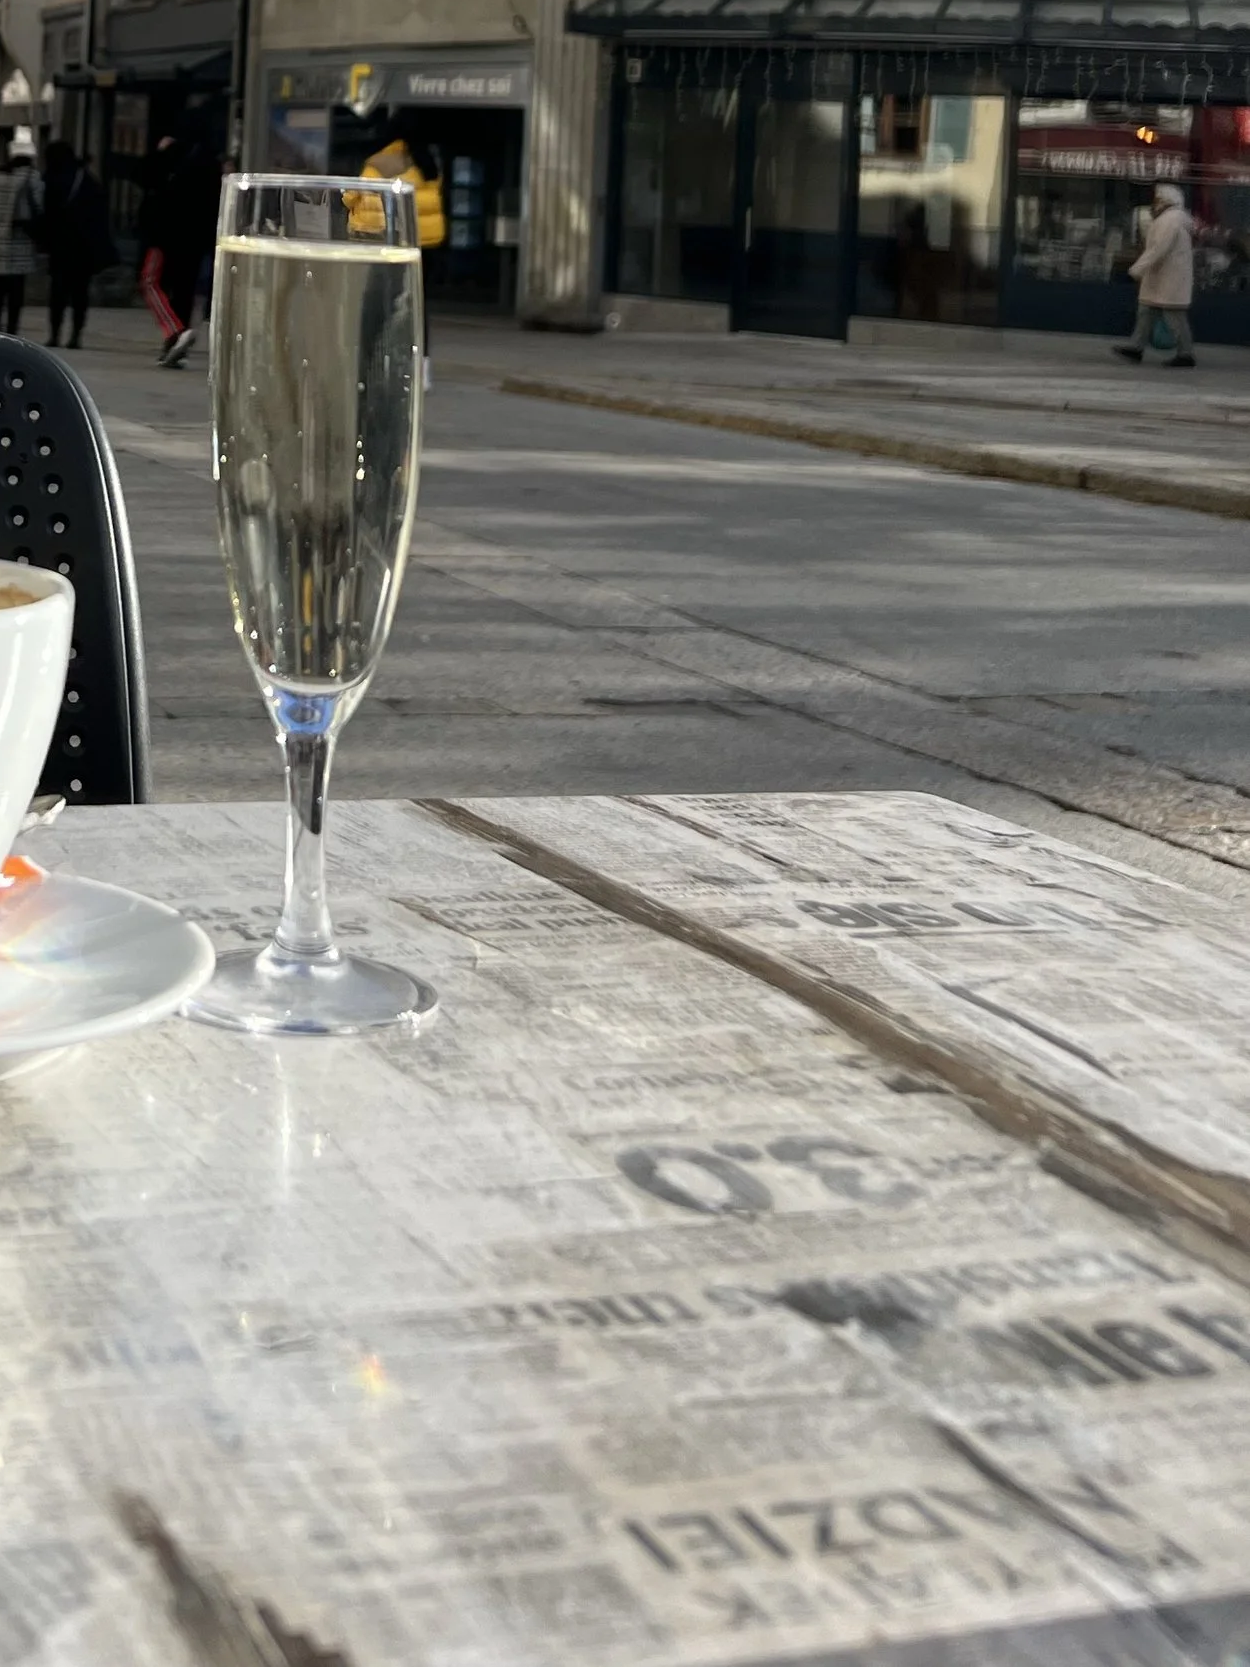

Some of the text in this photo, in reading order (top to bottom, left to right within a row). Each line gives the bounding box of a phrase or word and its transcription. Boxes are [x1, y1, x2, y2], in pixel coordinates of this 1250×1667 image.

[408, 73, 512, 97] Vivre chez soi
